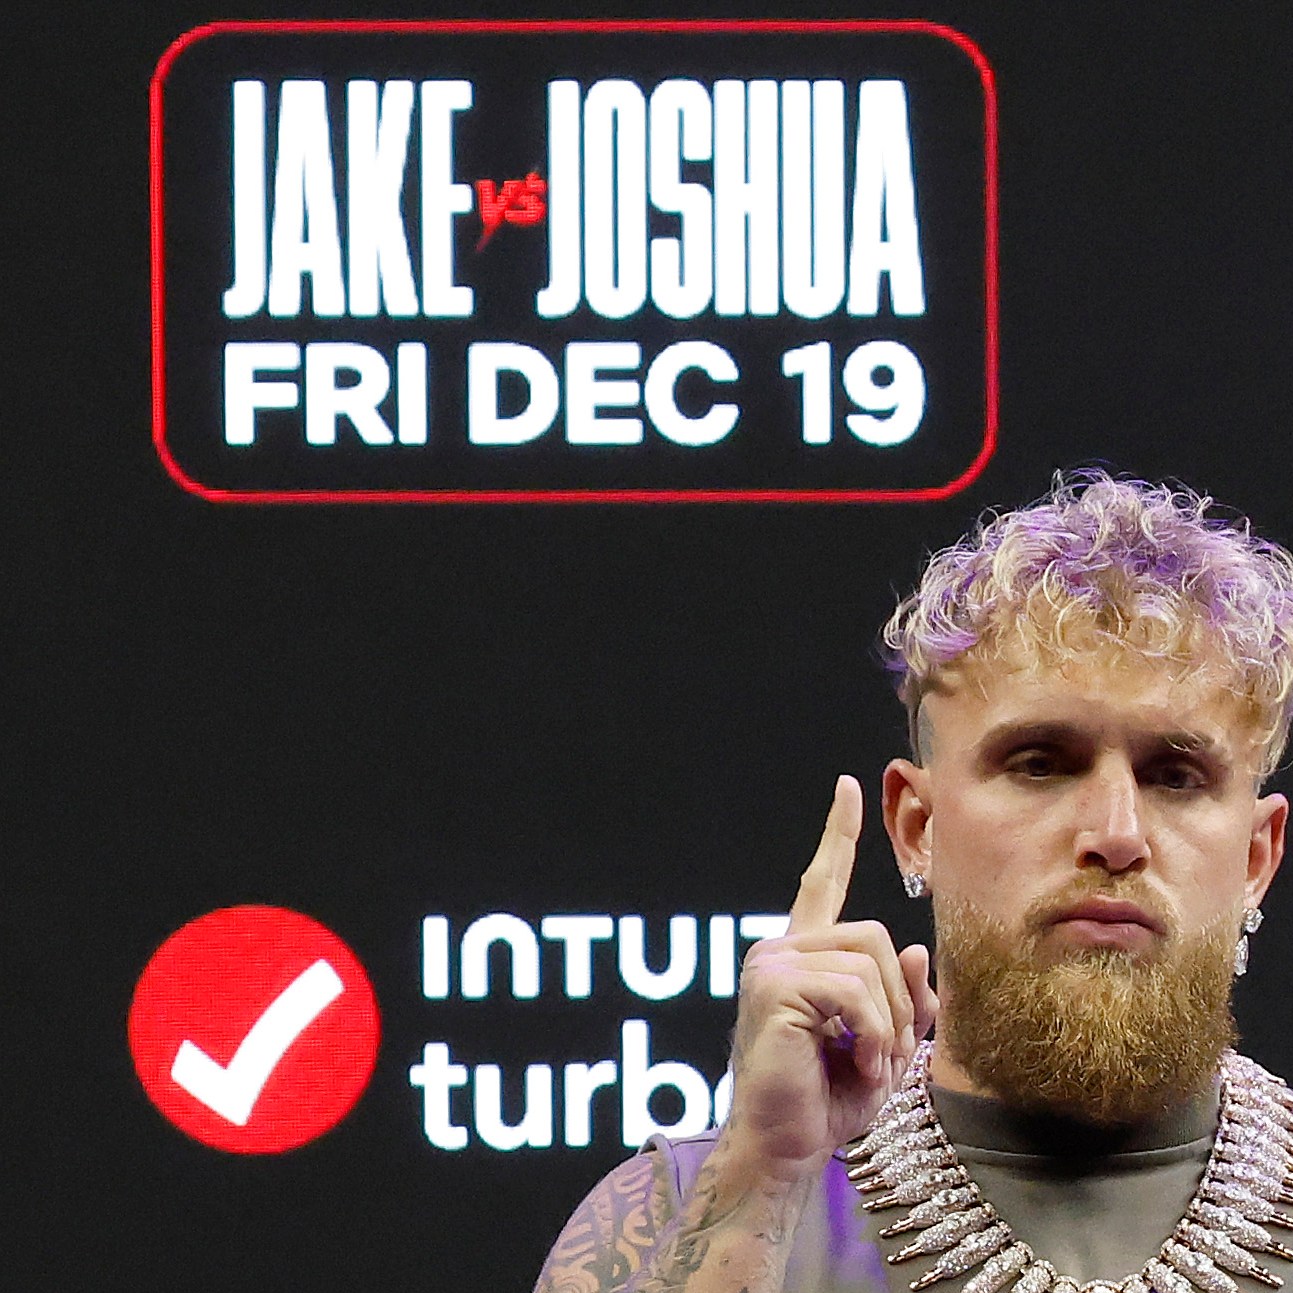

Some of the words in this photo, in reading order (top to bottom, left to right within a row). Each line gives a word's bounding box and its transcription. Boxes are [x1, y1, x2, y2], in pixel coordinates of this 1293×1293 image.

[223, 79, 474, 318] JAKE
[537, 79, 926, 319] JOSHUA
[224, 342, 427, 445] FRI
[468, 341, 740, 446] DEC
[782, 341, 926, 446] 19
[422, 913, 790, 1000] INTUI
[409, 1019, 733, 1150] turb
